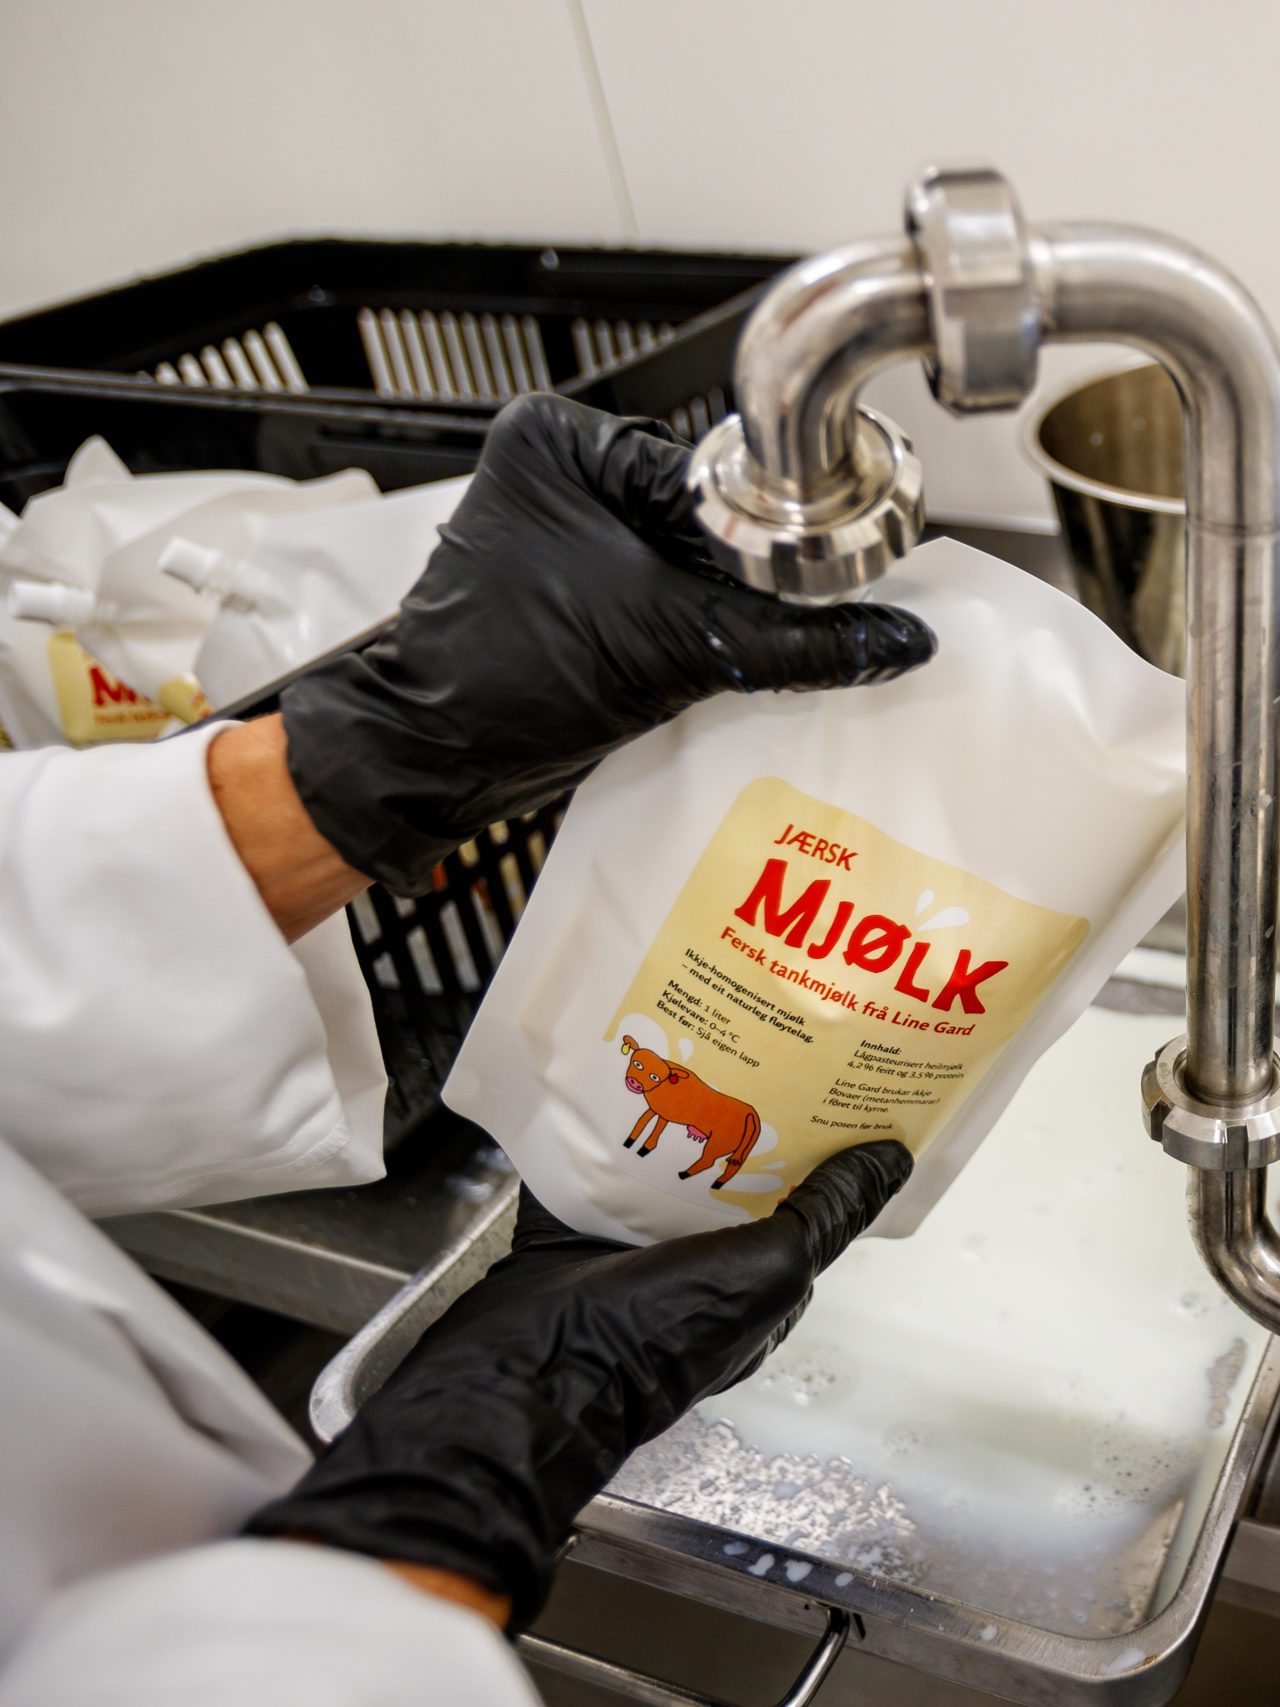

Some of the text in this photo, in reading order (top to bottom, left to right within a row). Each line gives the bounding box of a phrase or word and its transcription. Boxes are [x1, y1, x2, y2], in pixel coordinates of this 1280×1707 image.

[774, 824, 858, 871] JÆRSK
[734, 858, 1009, 1015] MJØLK
[684, 948, 806, 1027] Ikkje-homogenisert mjølk
[720, 926, 976, 1037] Fersk tankmjølk frå Line Gard
[662, 990, 709, 1025] Kjølevare:
[668, 979, 703, 1007] Mengd:
[711, 1008, 731, 1024] liter
[689, 968, 712, 985] med
[712, 982, 725, 995] eit
[726, 992, 769, 1022] naturleg
[768, 1016, 814, 1044] fløytelag.
[656, 1000, 760, 1068] Best før: Sjå eigen lapp
[860, 1040, 902, 1056] Innhald:
[853, 1050, 924, 1069] Lågpasteurisert
[875, 1065, 896, 1077] feitt
[896, 1070, 907, 1079] og
[829, 1087, 862, 1100] Bovaer
[835, 1078, 933, 1097] Line Gard brukar ikkje
[810, 1115, 829, 1126] Snu
[830, 1119, 858, 1130] posen
[859, 1121, 873, 1130] før
[851, 1103, 863, 1112] til
